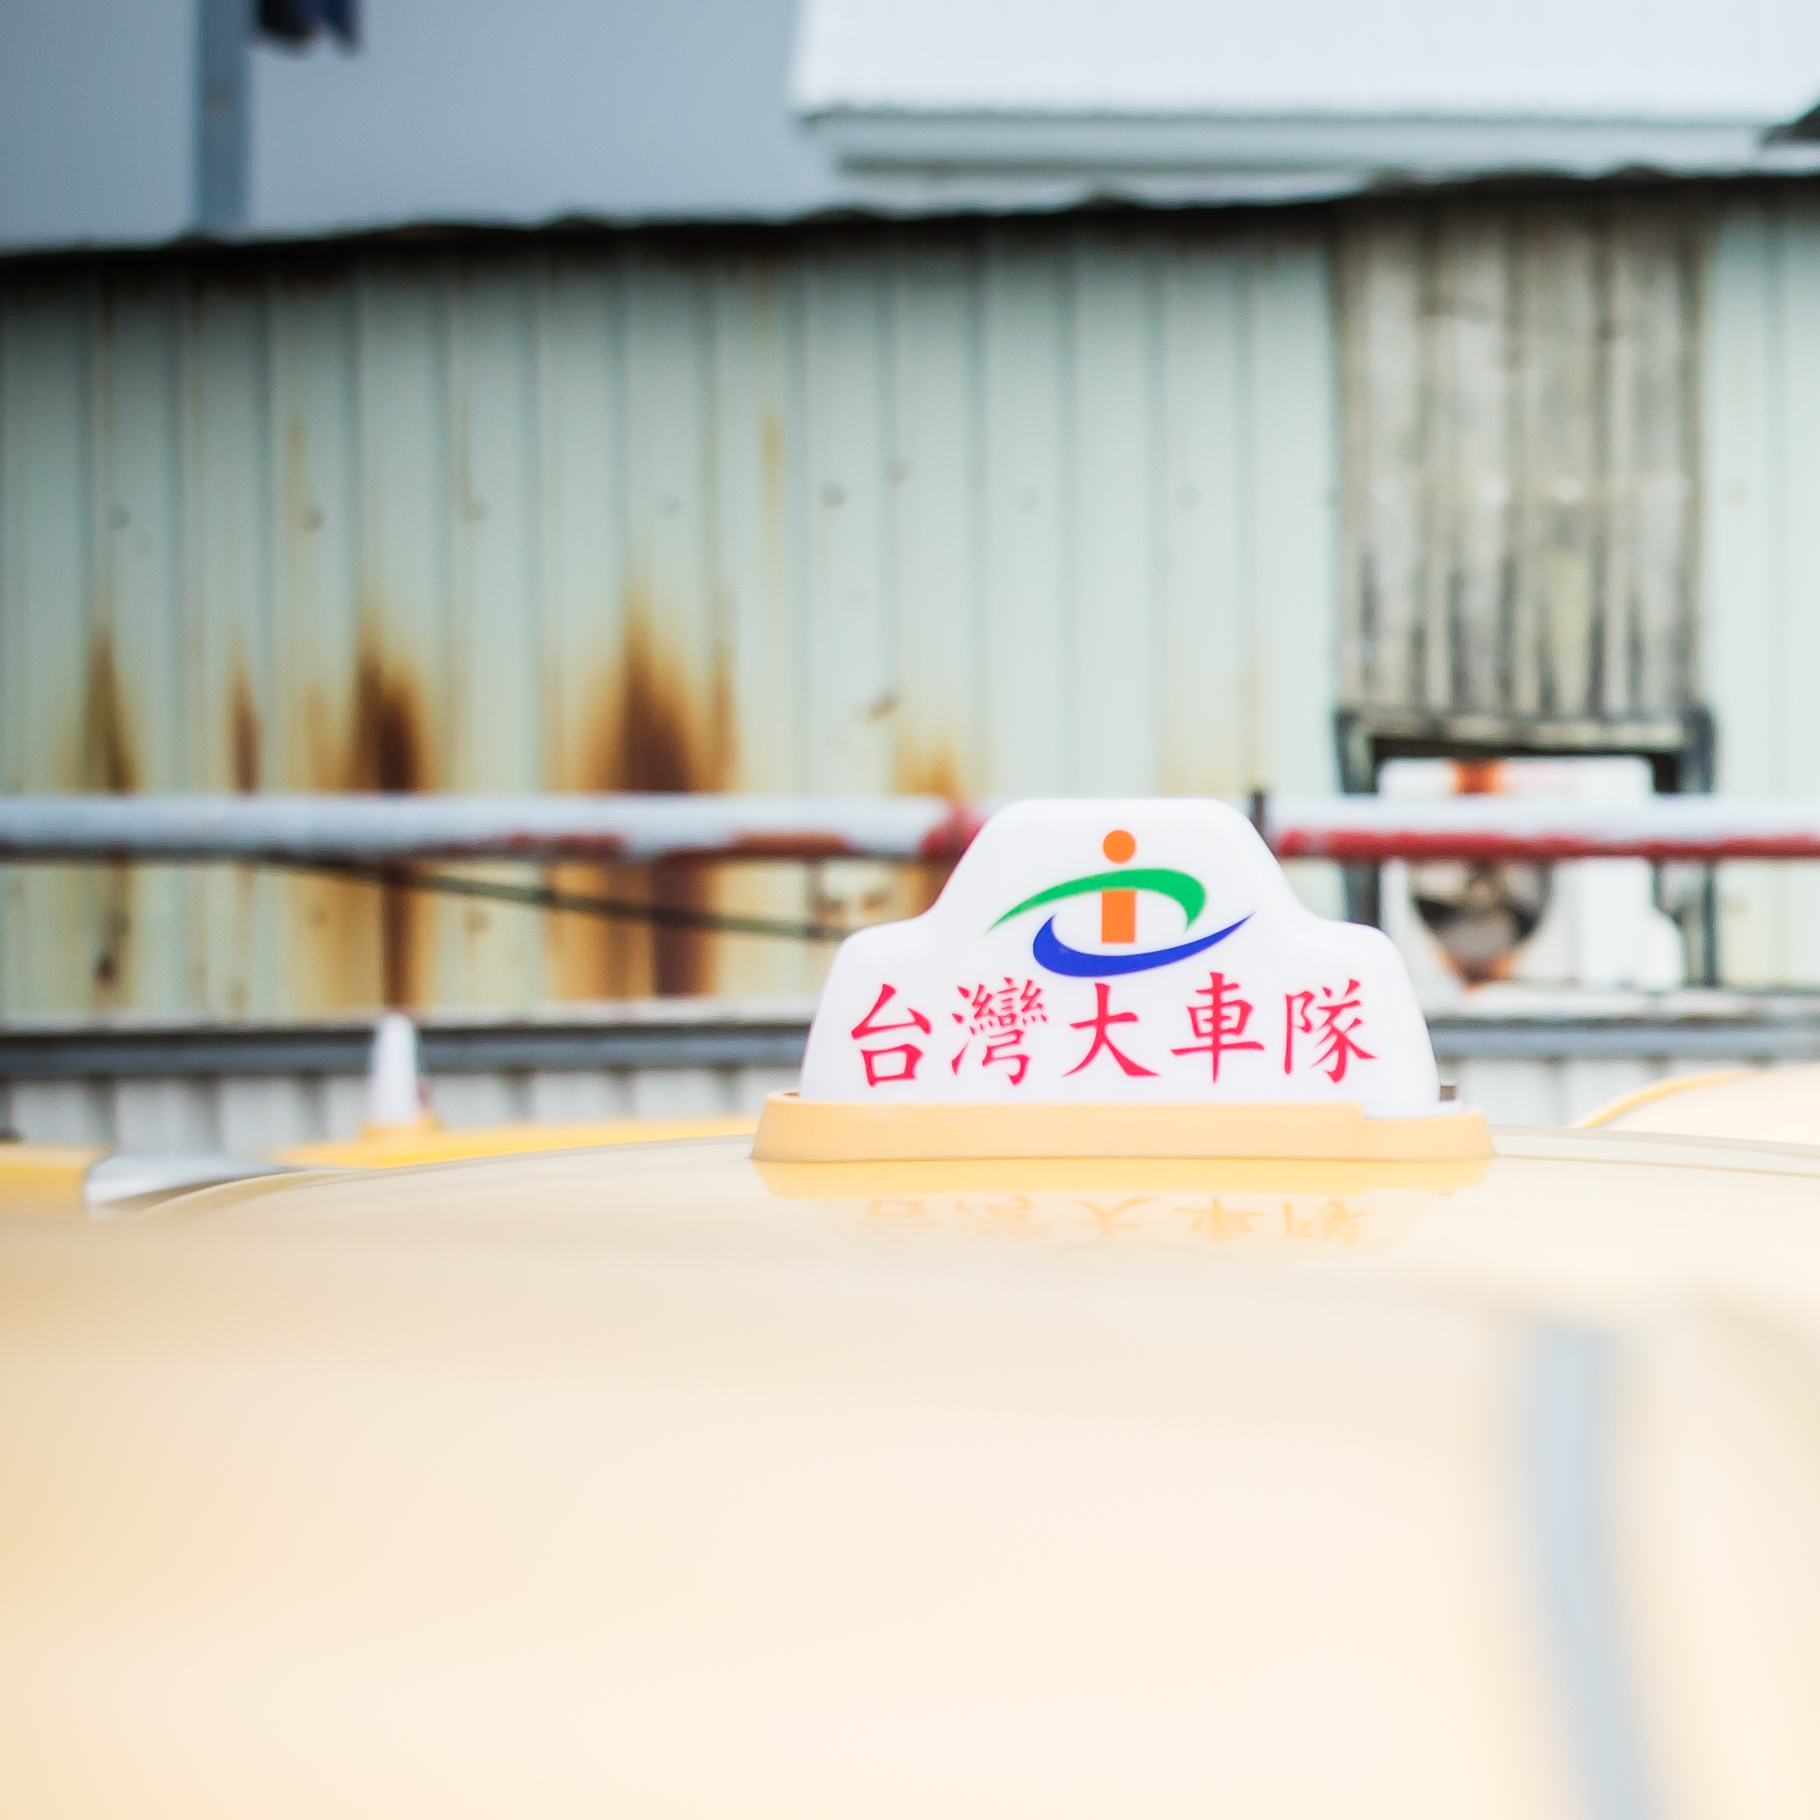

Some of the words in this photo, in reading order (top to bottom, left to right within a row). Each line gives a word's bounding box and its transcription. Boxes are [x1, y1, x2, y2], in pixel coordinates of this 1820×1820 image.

[850, 971, 1379, 1086] 台灣大車隊
